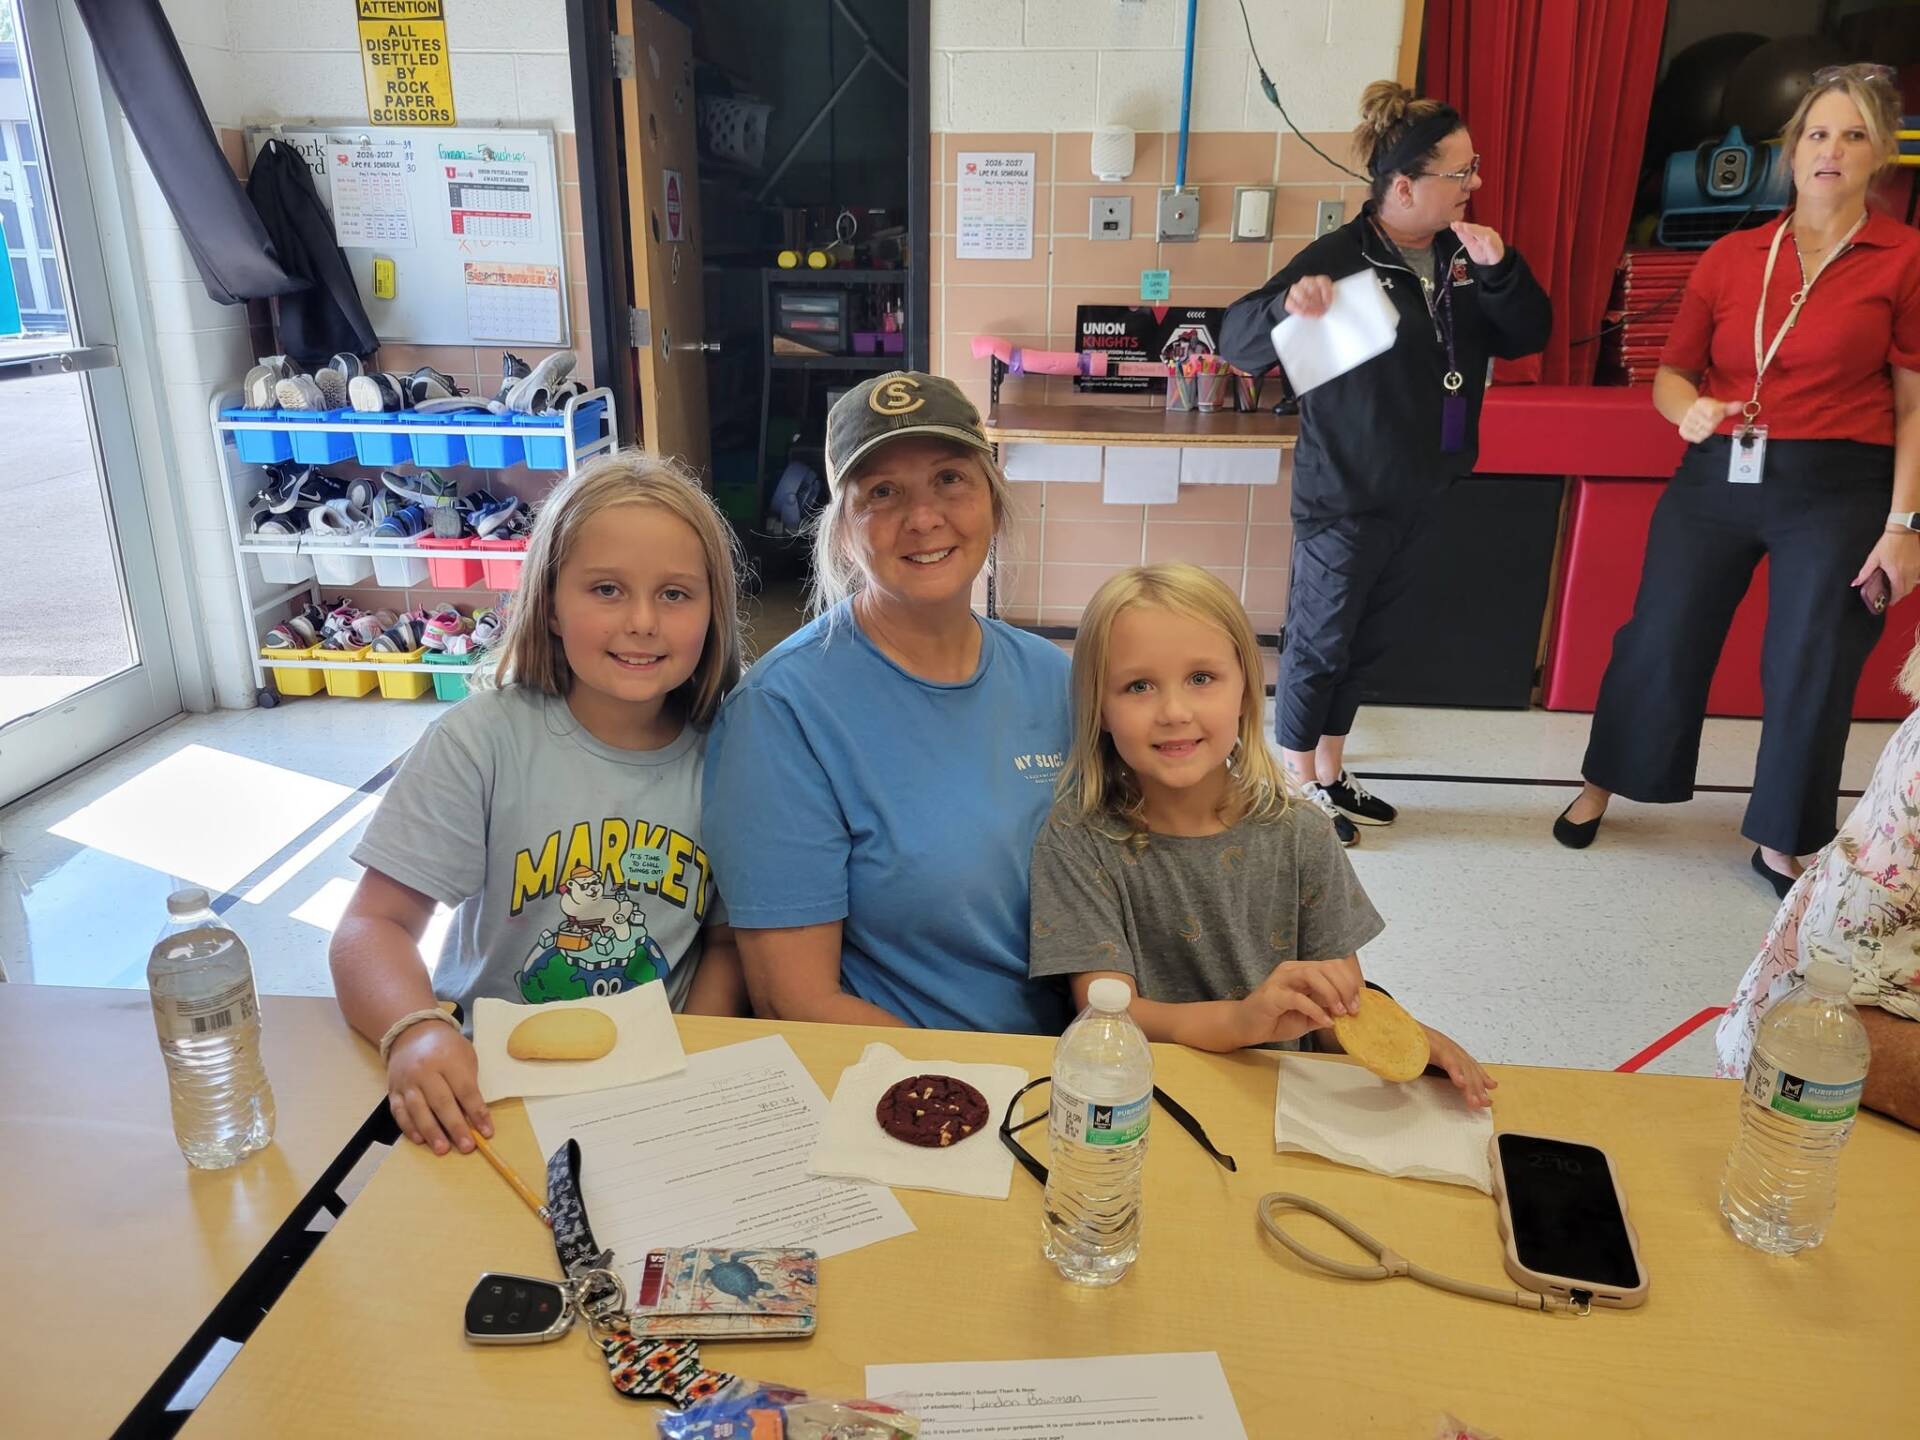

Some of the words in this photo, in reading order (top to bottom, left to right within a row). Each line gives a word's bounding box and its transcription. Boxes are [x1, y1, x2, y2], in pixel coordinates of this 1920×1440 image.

[362, 1, 437, 13] ATTENTION
[388, 25, 417, 37] ALL
[366, 39, 441, 51] DISPUTES
[371, 53, 439, 65] SETTLED
[396, 67, 416, 79] BY
[386, 81, 430, 93] ROCK
[384, 95, 436, 107] PAPER
[373, 109, 450, 121] SCISSORS
[1082, 322, 1126, 335] UNION
[1082, 335, 1139, 348] KNIGHTS
[510, 817, 711, 925] MARKET
